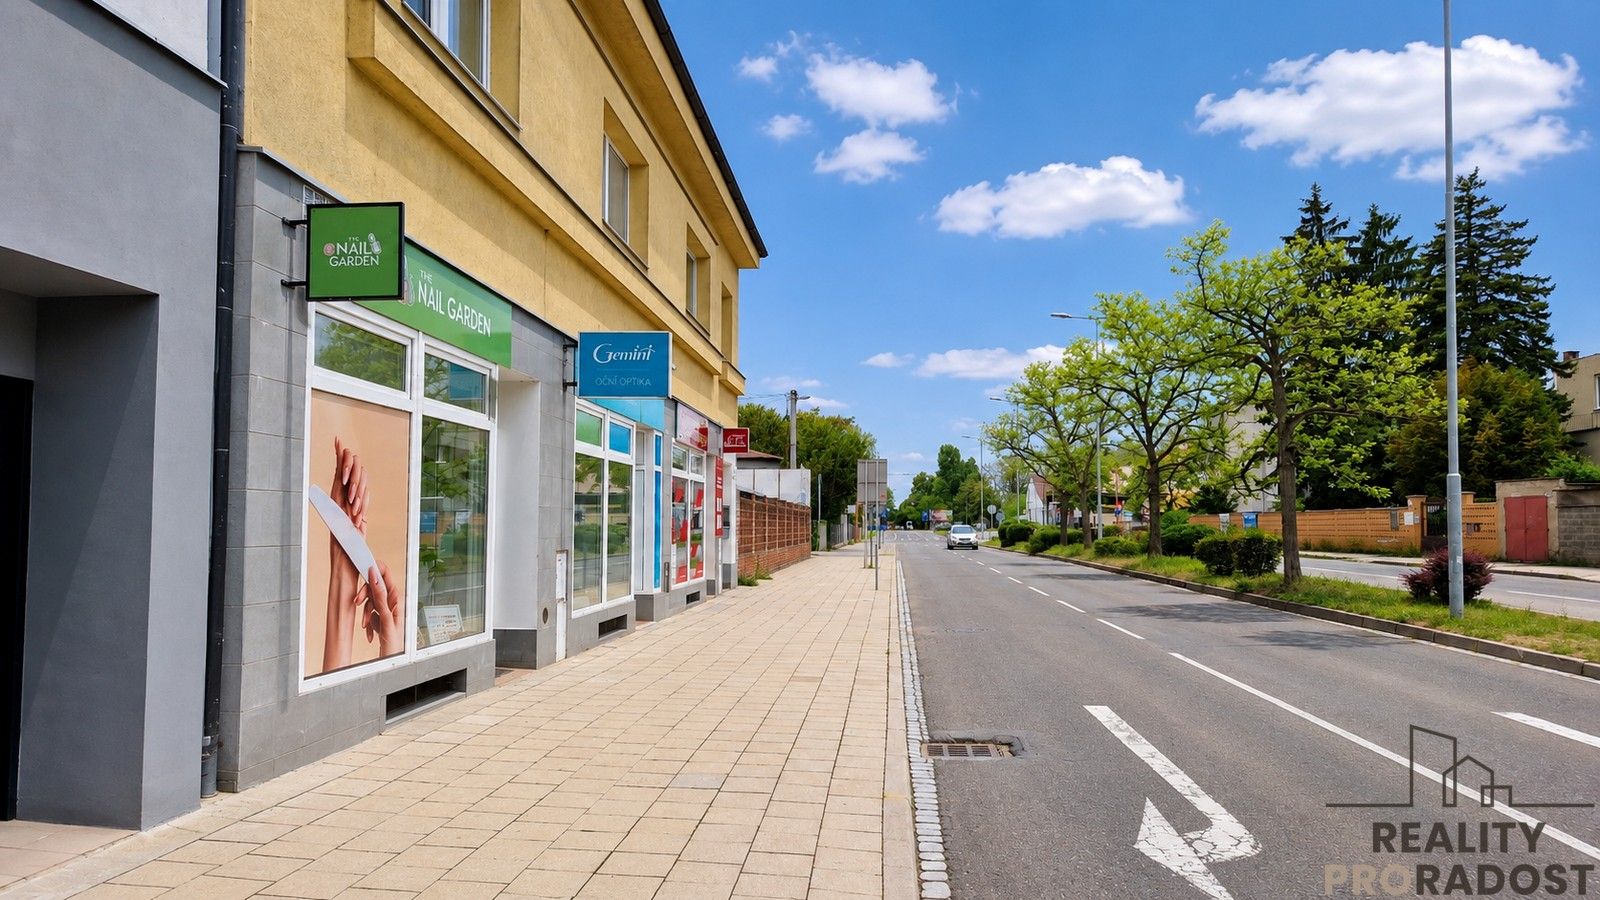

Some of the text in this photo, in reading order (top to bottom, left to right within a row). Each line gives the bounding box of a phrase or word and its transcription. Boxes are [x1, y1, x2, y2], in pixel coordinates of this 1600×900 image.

[336, 241, 373, 255] NAIL
[329, 255, 379, 267] GARDEN
[420, 269, 433, 285] THE
[418, 280, 491, 337] NAIL GARDEN
[592, 343, 656, 364] Gemini
[620, 376, 652, 386] OPTIKA
